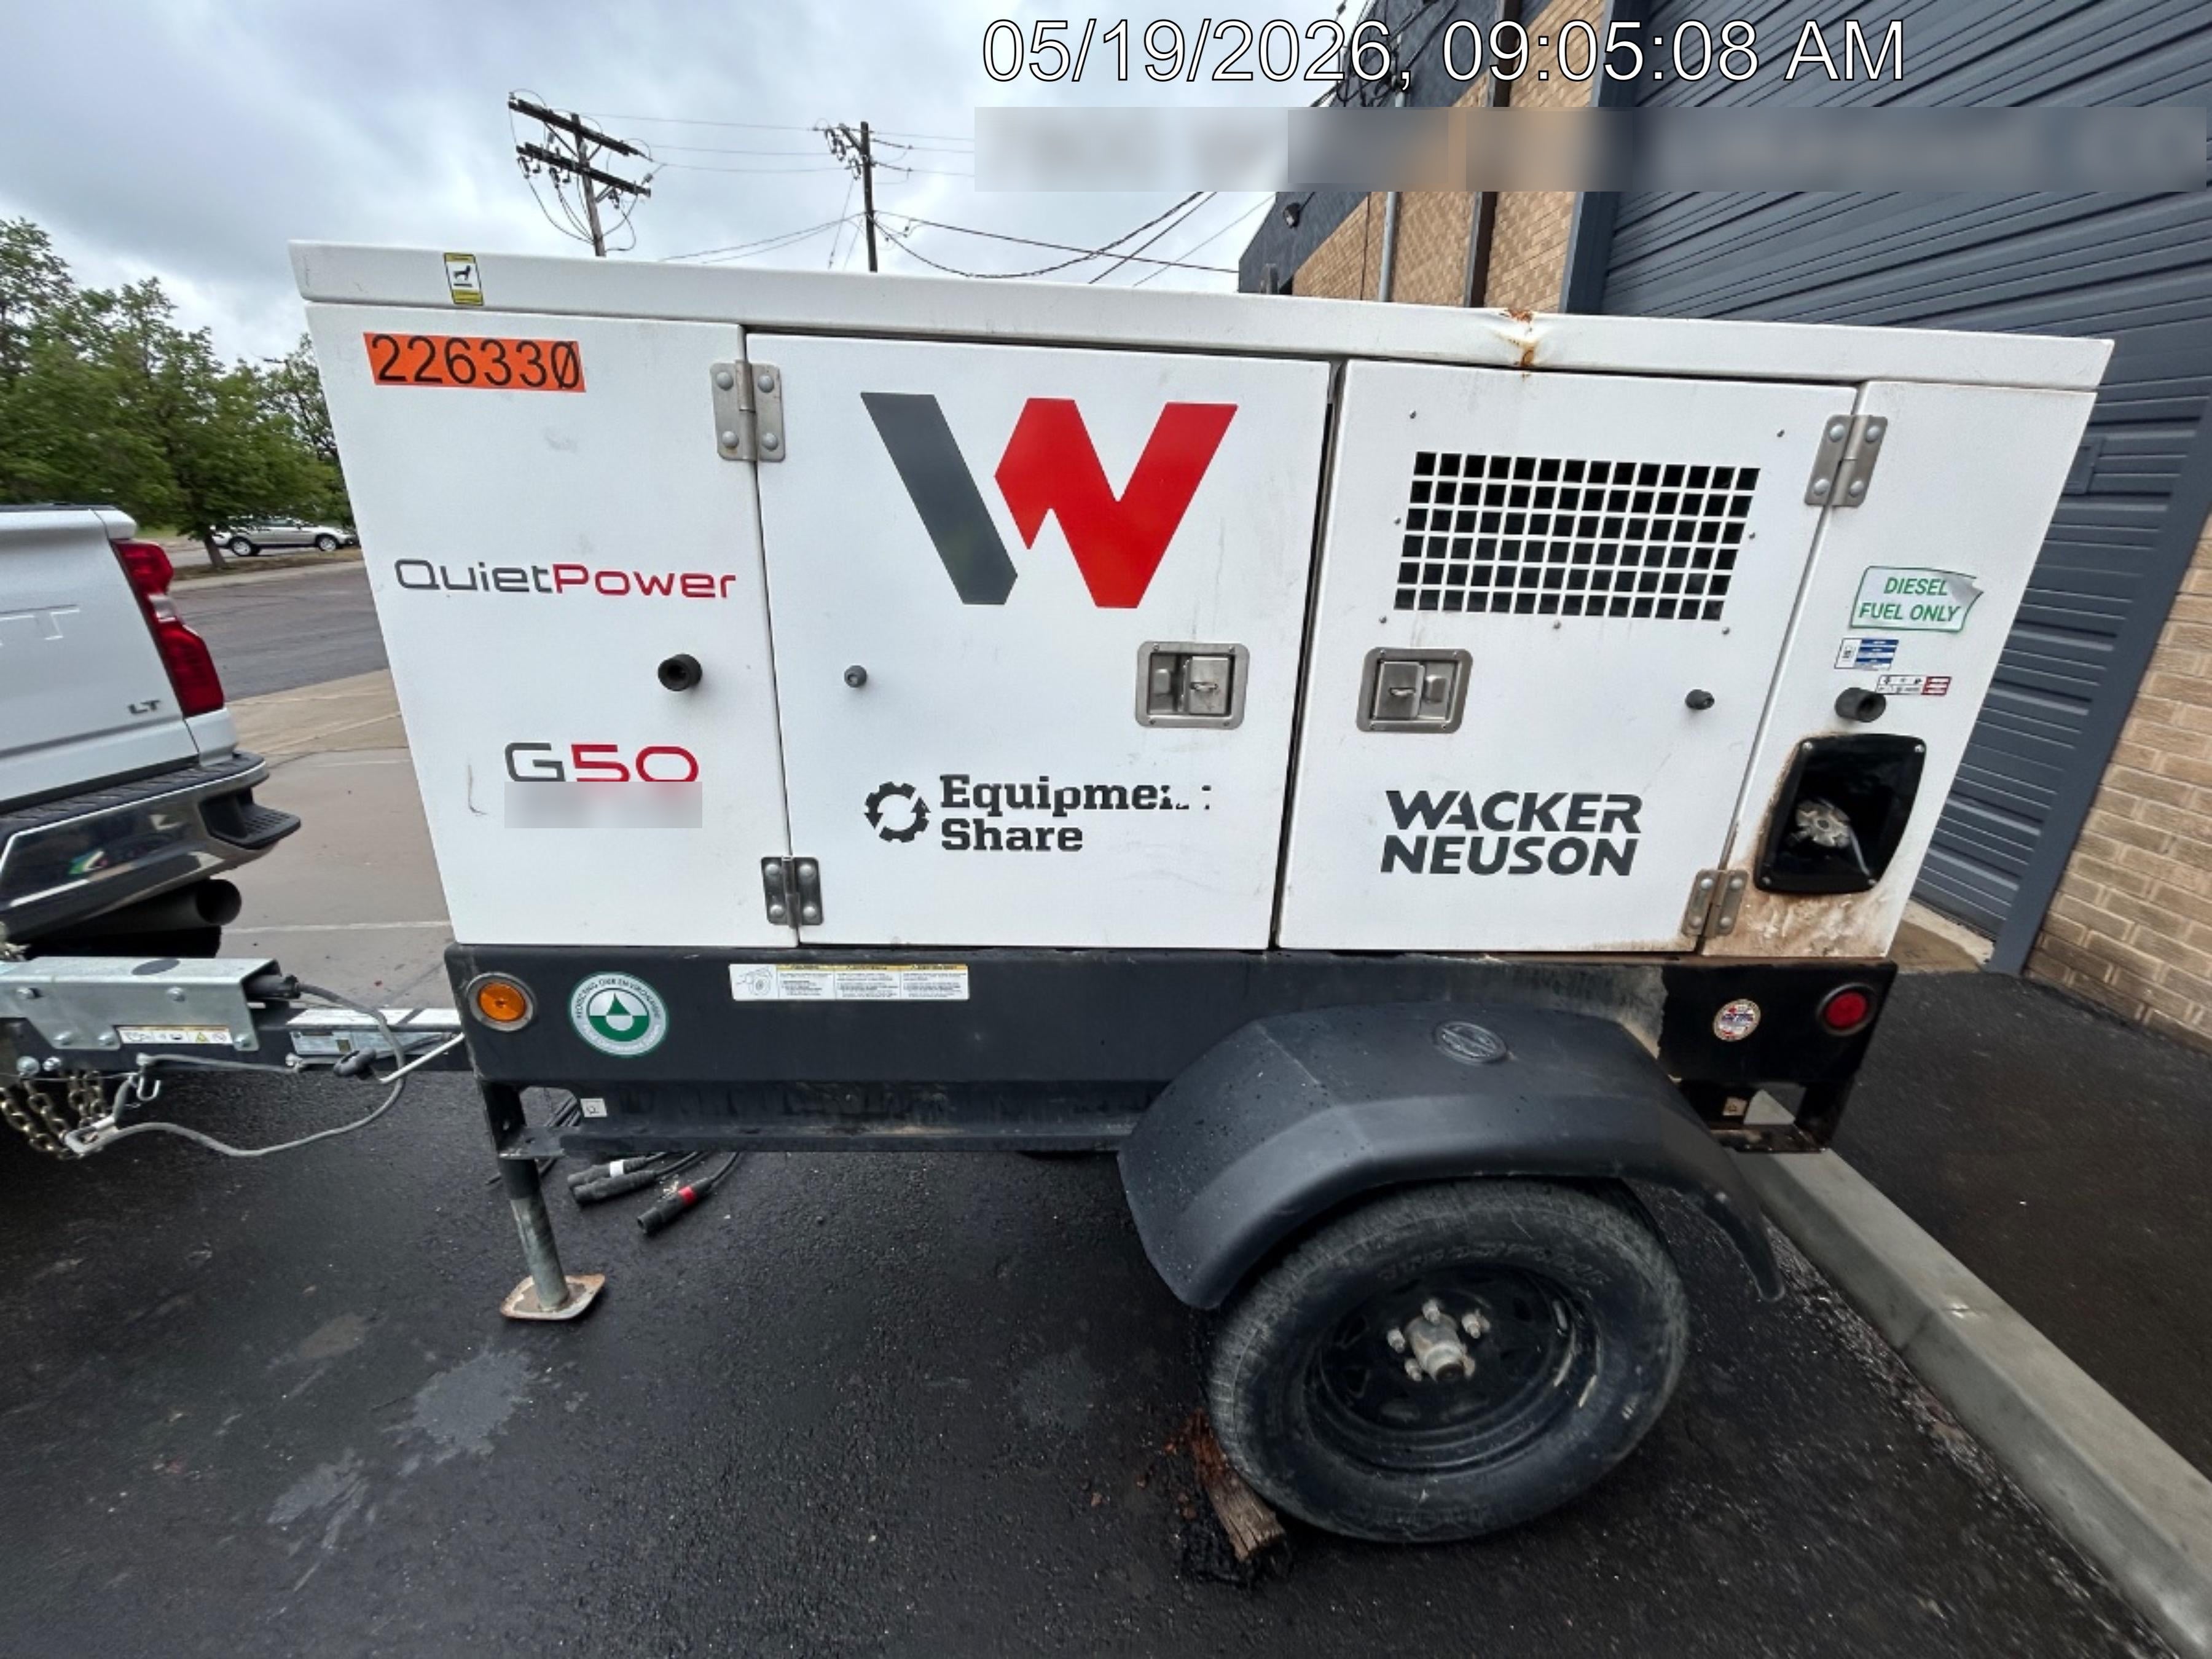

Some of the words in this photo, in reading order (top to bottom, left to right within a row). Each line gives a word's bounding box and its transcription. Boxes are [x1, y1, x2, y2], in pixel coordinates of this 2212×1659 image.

[372, 334, 579, 389] 226330
[394, 559, 737, 599] QuietPower
[1883, 576, 1948, 596] DIESEL
[1859, 603, 1904, 620] FUEL
[1910, 604, 1961, 622] ONLY
[128, 699, 161, 715] LT
[505, 742, 699, 783] G50
[1386, 791, 1642, 833] WACKER
[941, 819, 1083, 852] Share
[1381, 835, 1639, 876] NEUSON
